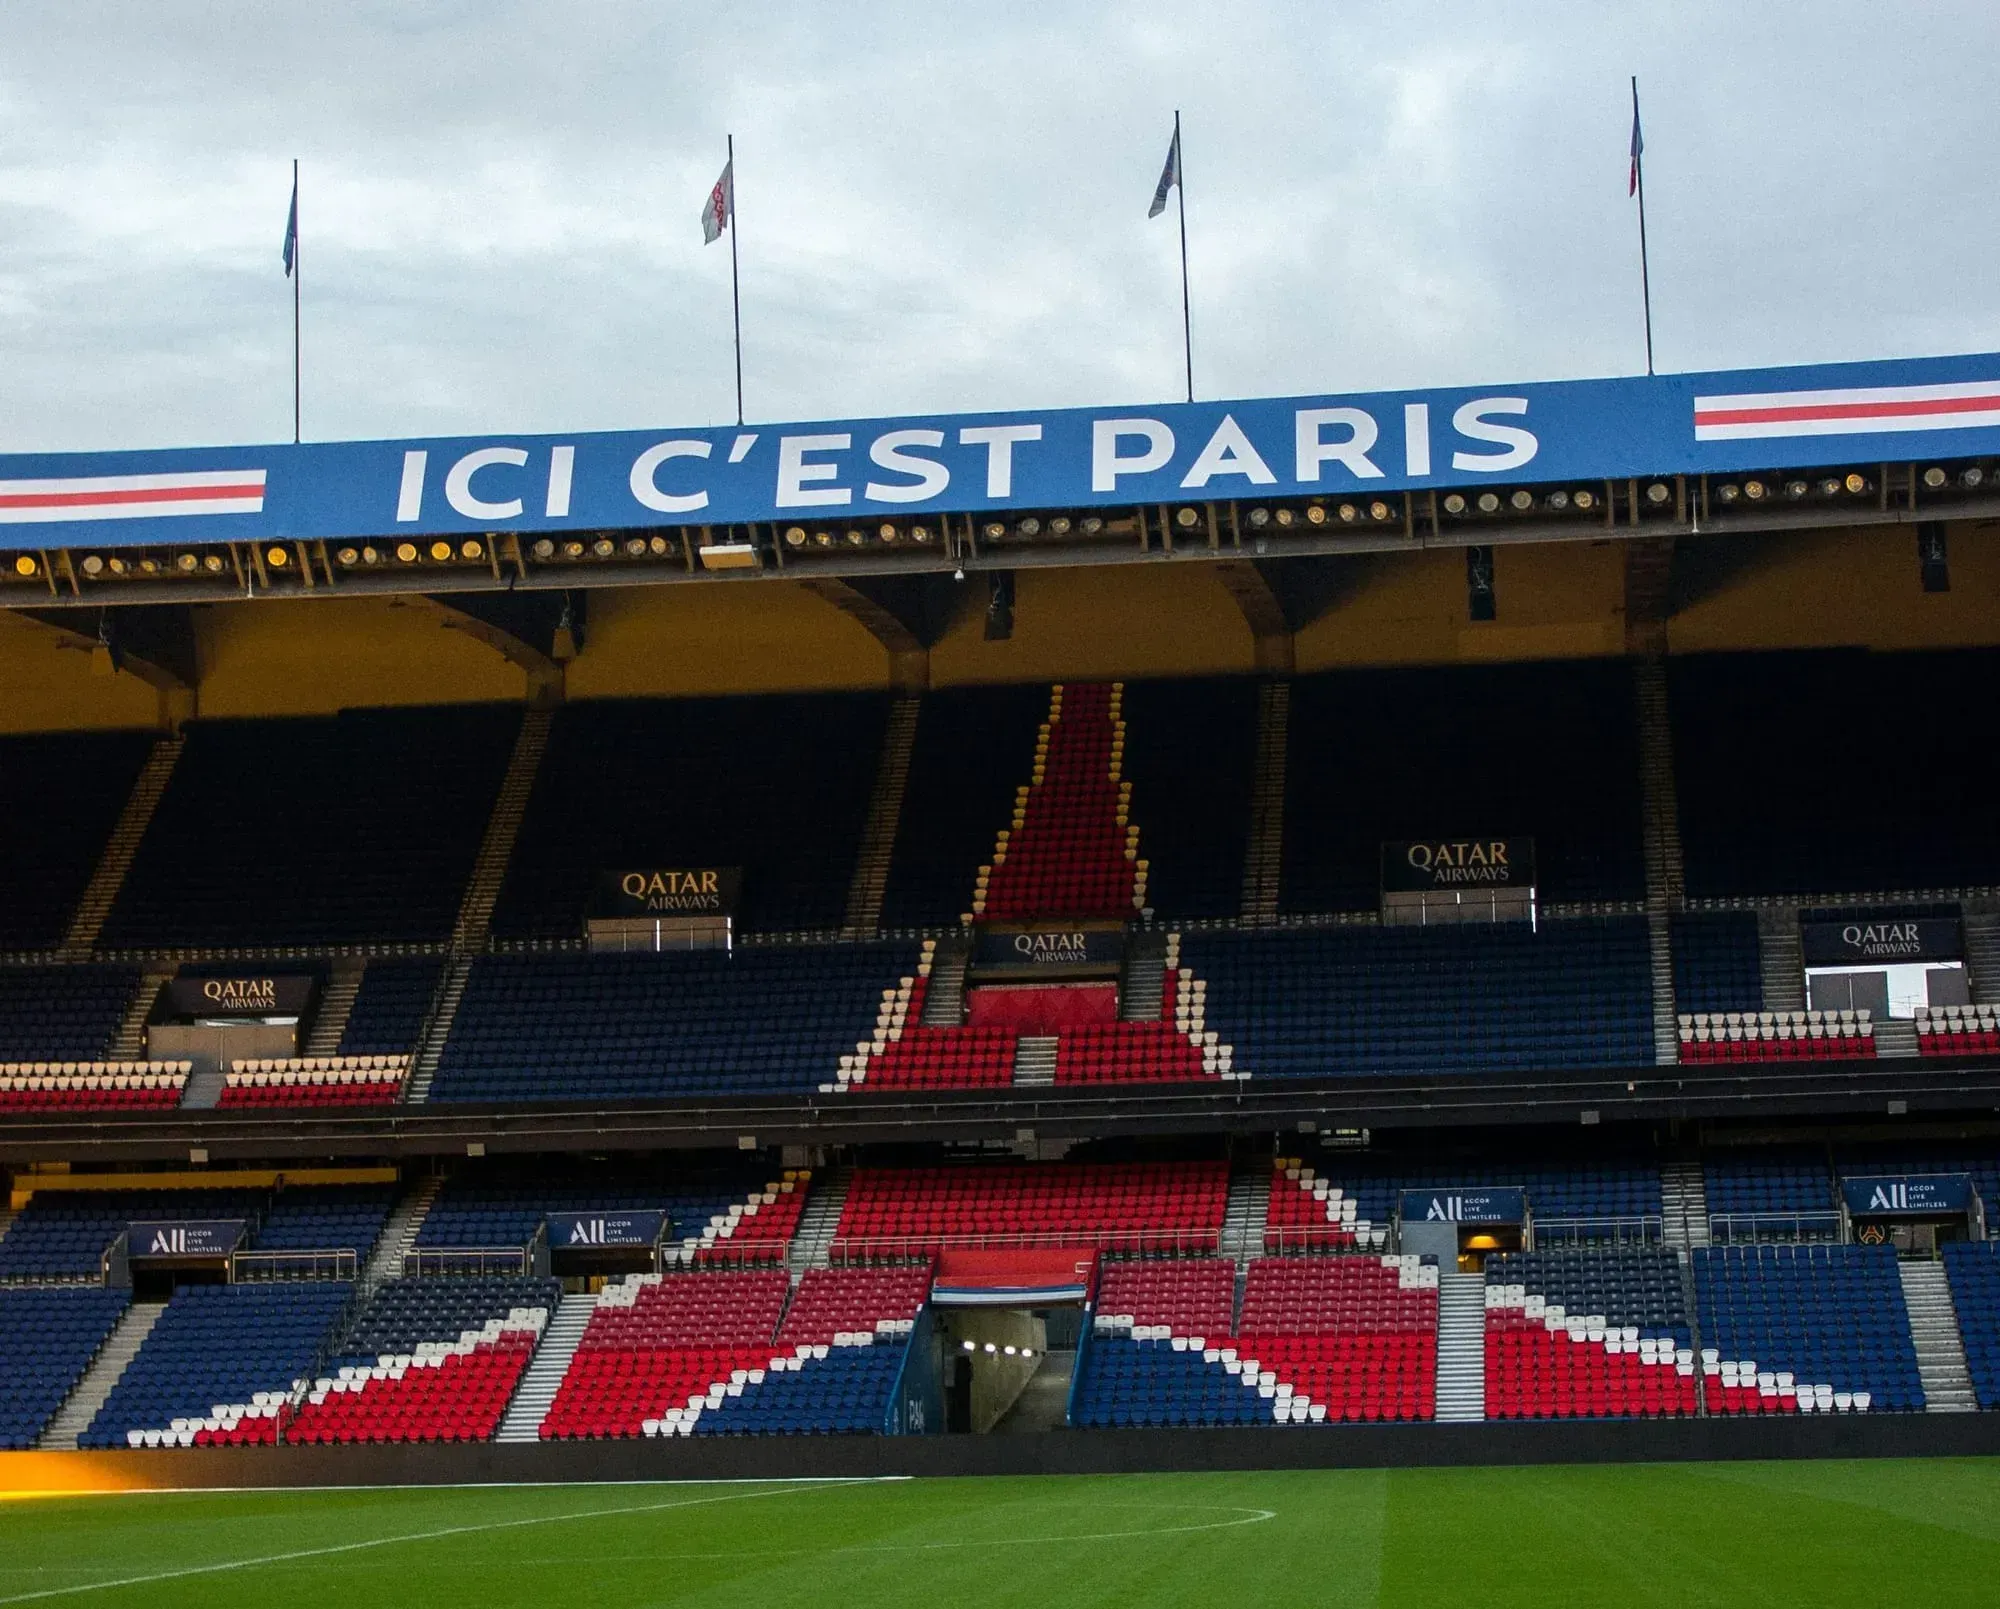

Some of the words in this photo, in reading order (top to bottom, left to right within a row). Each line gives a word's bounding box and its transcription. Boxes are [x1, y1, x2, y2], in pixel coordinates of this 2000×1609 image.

[396, 445, 575, 522] ICI
[629, 424, 1042, 513] C'EST
[1092, 397, 1538, 492] PARIS
[1407, 841, 1508, 872] QATAR
[1434, 865, 1509, 882] AIRWAYS
[622, 871, 718, 899] QATAR
[647, 894, 720, 909] AIRWAYS
[1014, 932, 1085, 955] QATAR
[1842, 923, 1919, 946] QATAR
[1032, 950, 1087, 962] AIRWAYS
[1862, 941, 1920, 954] AIRWAYS
[203, 979, 276, 1000] QATAR
[221, 996, 276, 1009] AIRWAYS
[1908, 1201, 1947, 1209] LIMITLESS
